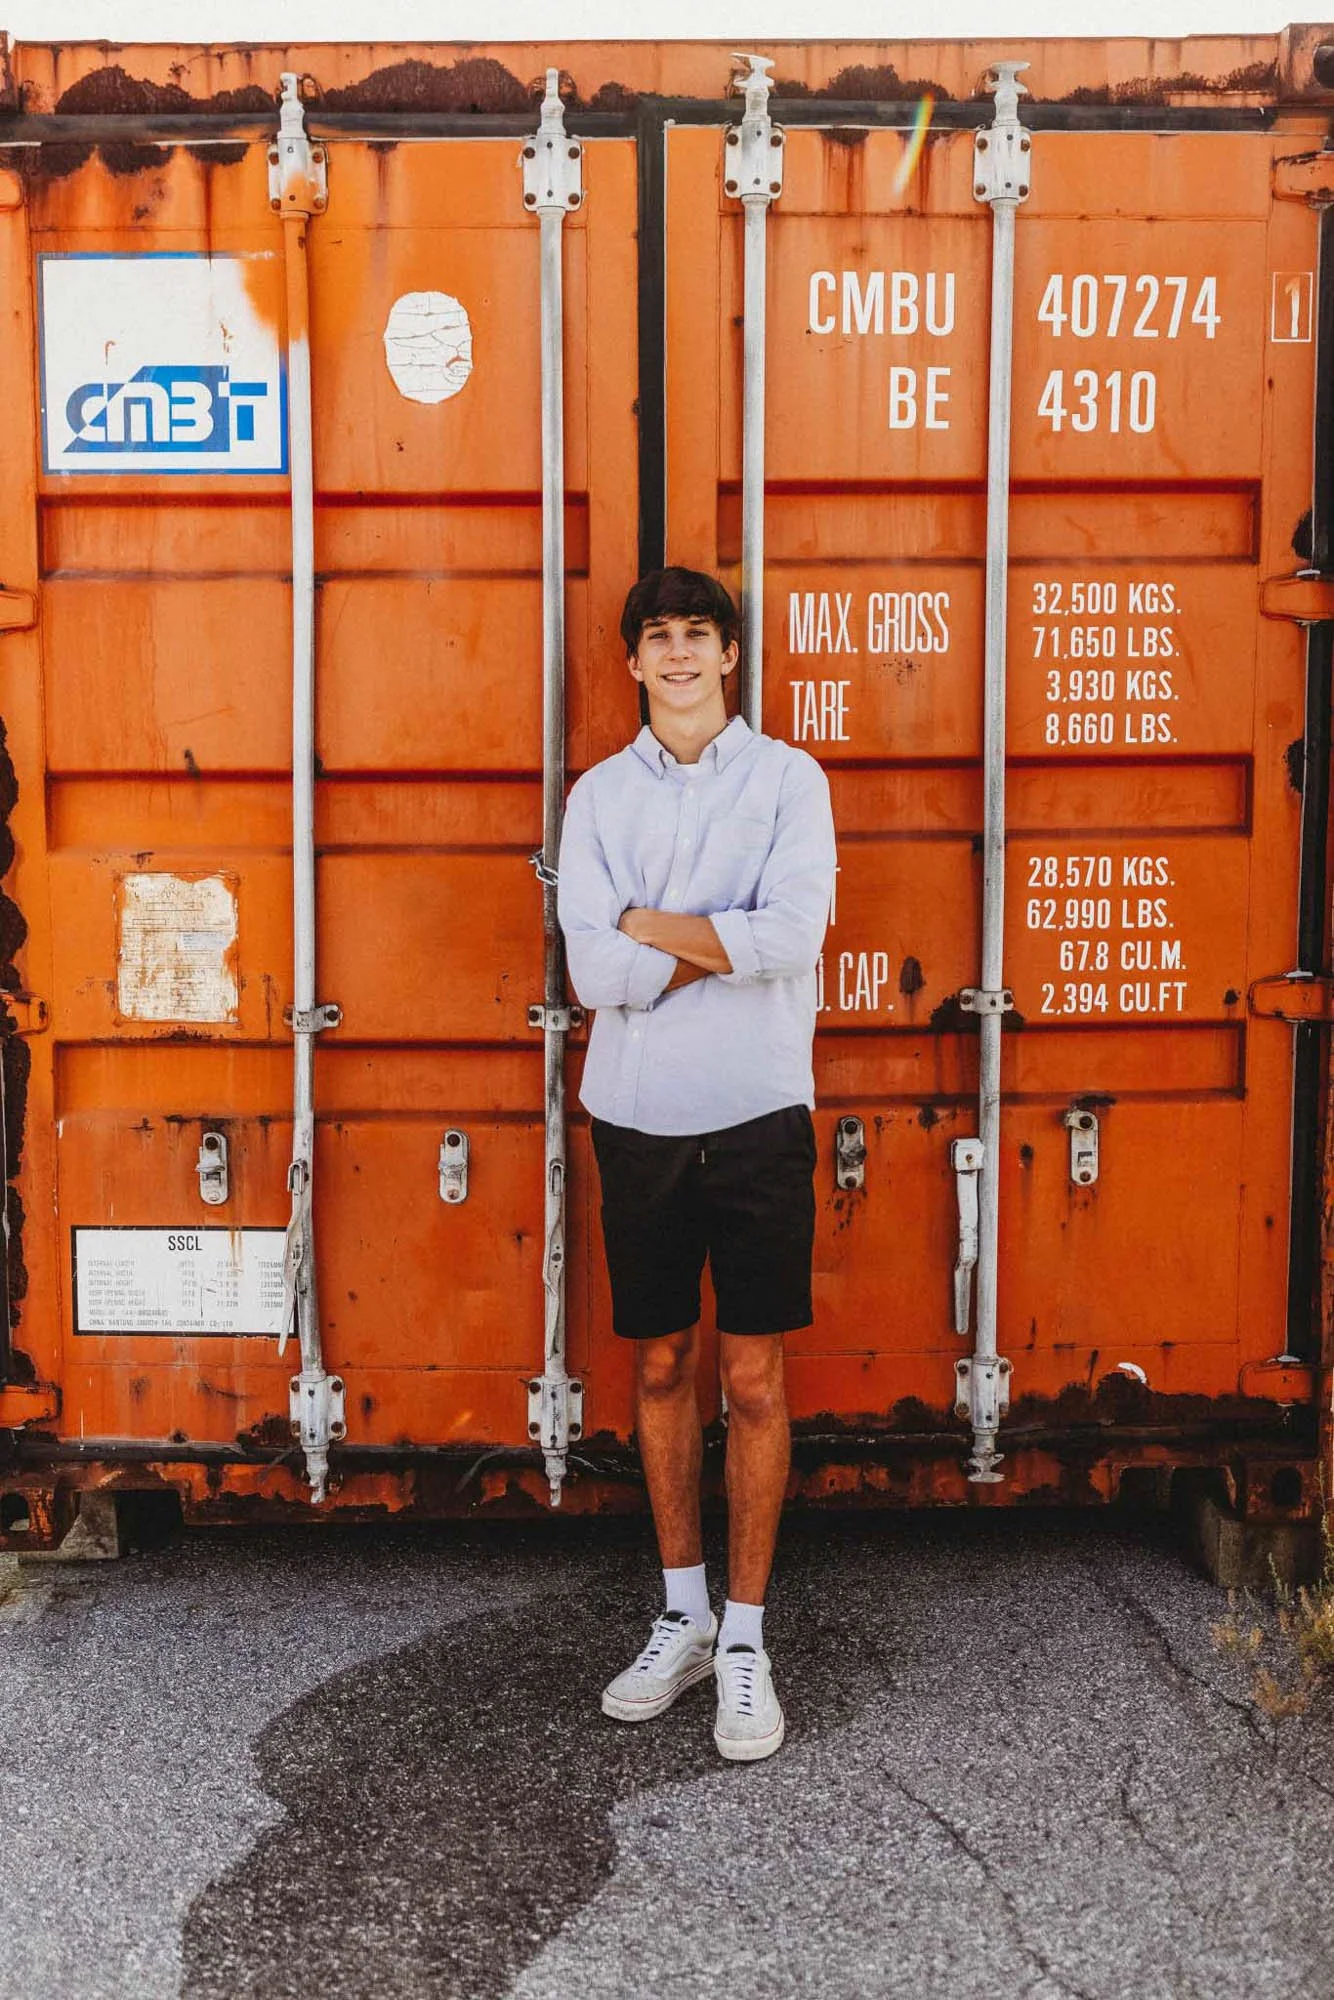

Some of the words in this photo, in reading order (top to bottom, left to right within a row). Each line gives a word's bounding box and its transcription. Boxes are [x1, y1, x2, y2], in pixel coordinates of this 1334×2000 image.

[808, 270, 956, 337] CMBU
[1037, 273, 1222, 339] 407274
[1284, 276, 1301, 338] 1
[888, 366, 951, 431] BE
[1037, 369, 1157, 434] 4310
[1032, 582, 1117, 616] 32,500
[1128, 583, 1182, 614] KGS.
[789, 592, 858, 654] MAX.
[867, 591, 950, 654] GROSS
[1032, 626, 1116, 660] 71,650
[1127, 626, 1180, 657] LBS.
[1046, 669, 1115, 703] 3,930
[1126, 670, 1179, 701] KGS.
[789, 680, 851, 741] TARE
[1045, 712, 1114, 746] 8,660
[1125, 712, 1178, 743] LBS.
[1027, 856, 1112, 889] 28,570
[1123, 856, 1175, 886] KGS.
[1026, 898, 1111, 931] 62,990
[1121, 898, 1174, 929] LBS.
[1059, 940, 1109, 971] 67.8
[839, 951, 894, 1011] CAP.
[1041, 982, 1109, 1015] 2,394
[168, 1235, 203, 1251] SSCL
